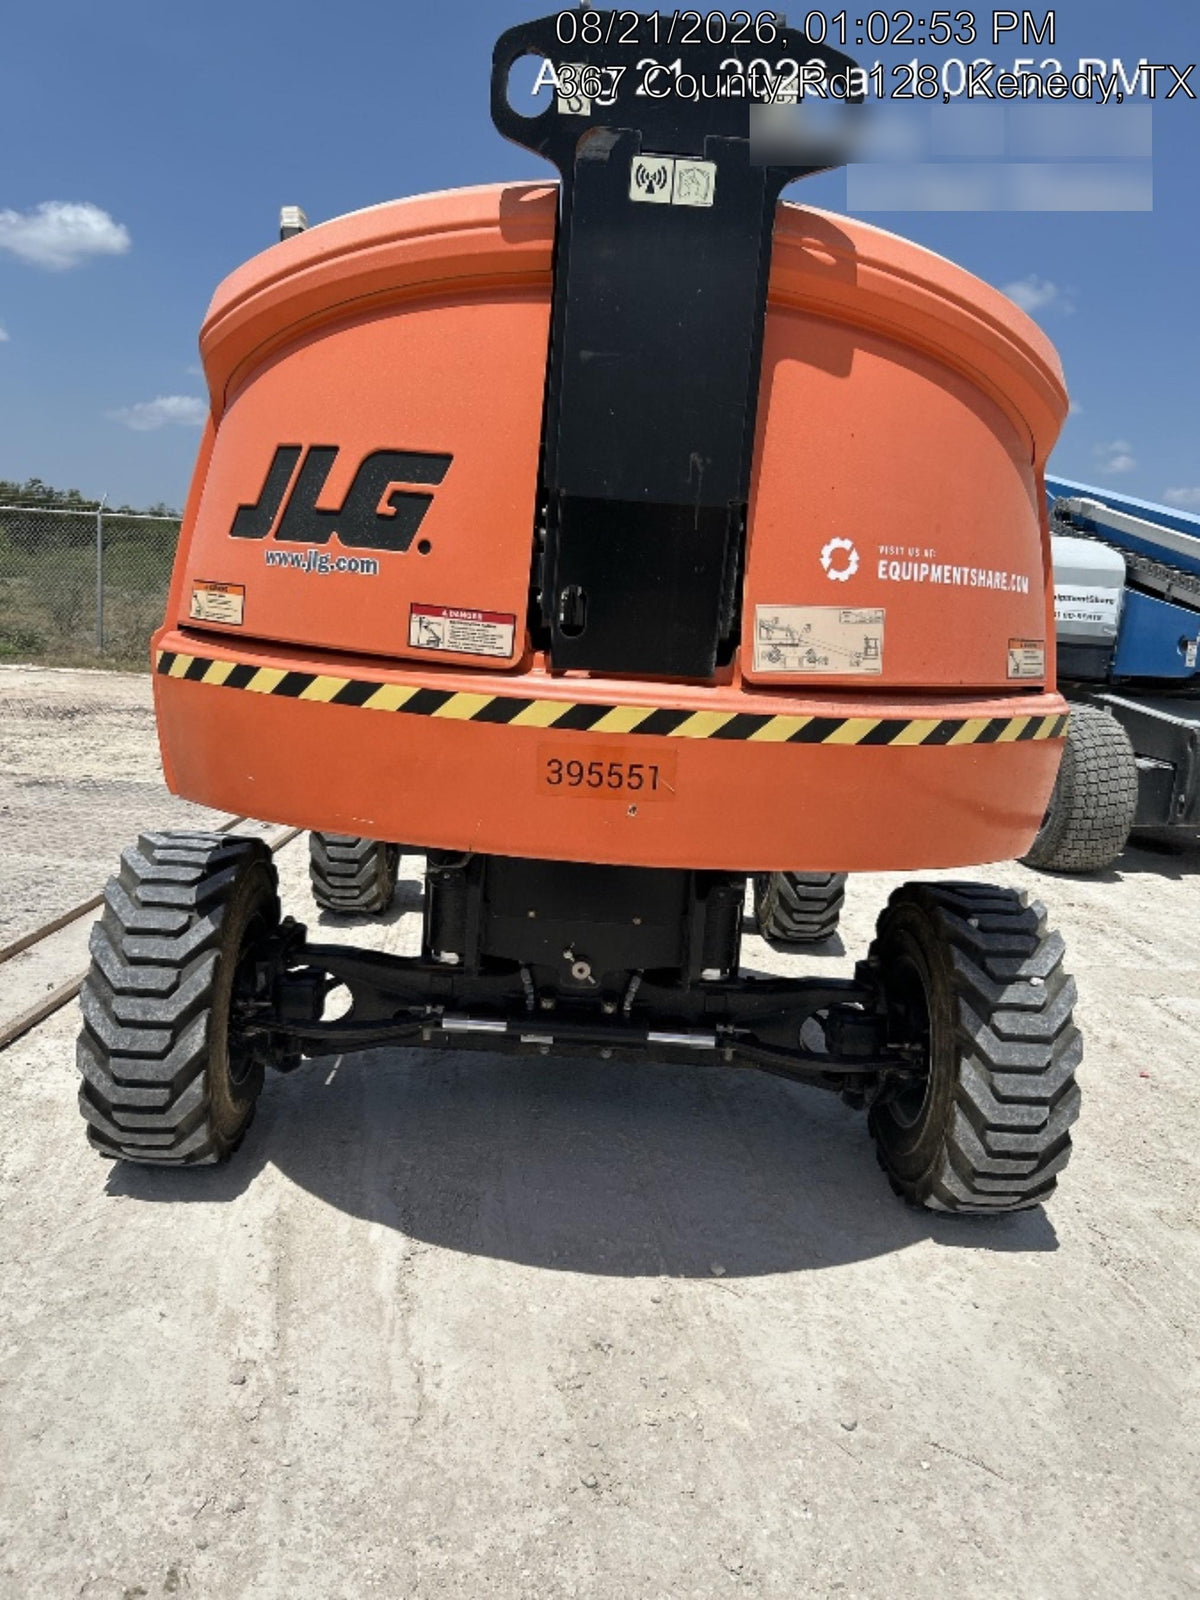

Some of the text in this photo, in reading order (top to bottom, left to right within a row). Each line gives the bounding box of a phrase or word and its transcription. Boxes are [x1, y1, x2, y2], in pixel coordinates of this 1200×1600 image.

[265, 549, 379, 576] www.jlg.com
[877, 559, 1030, 594] EQUIPMENTSHARE.COM
[546, 758, 659, 791] 395551
